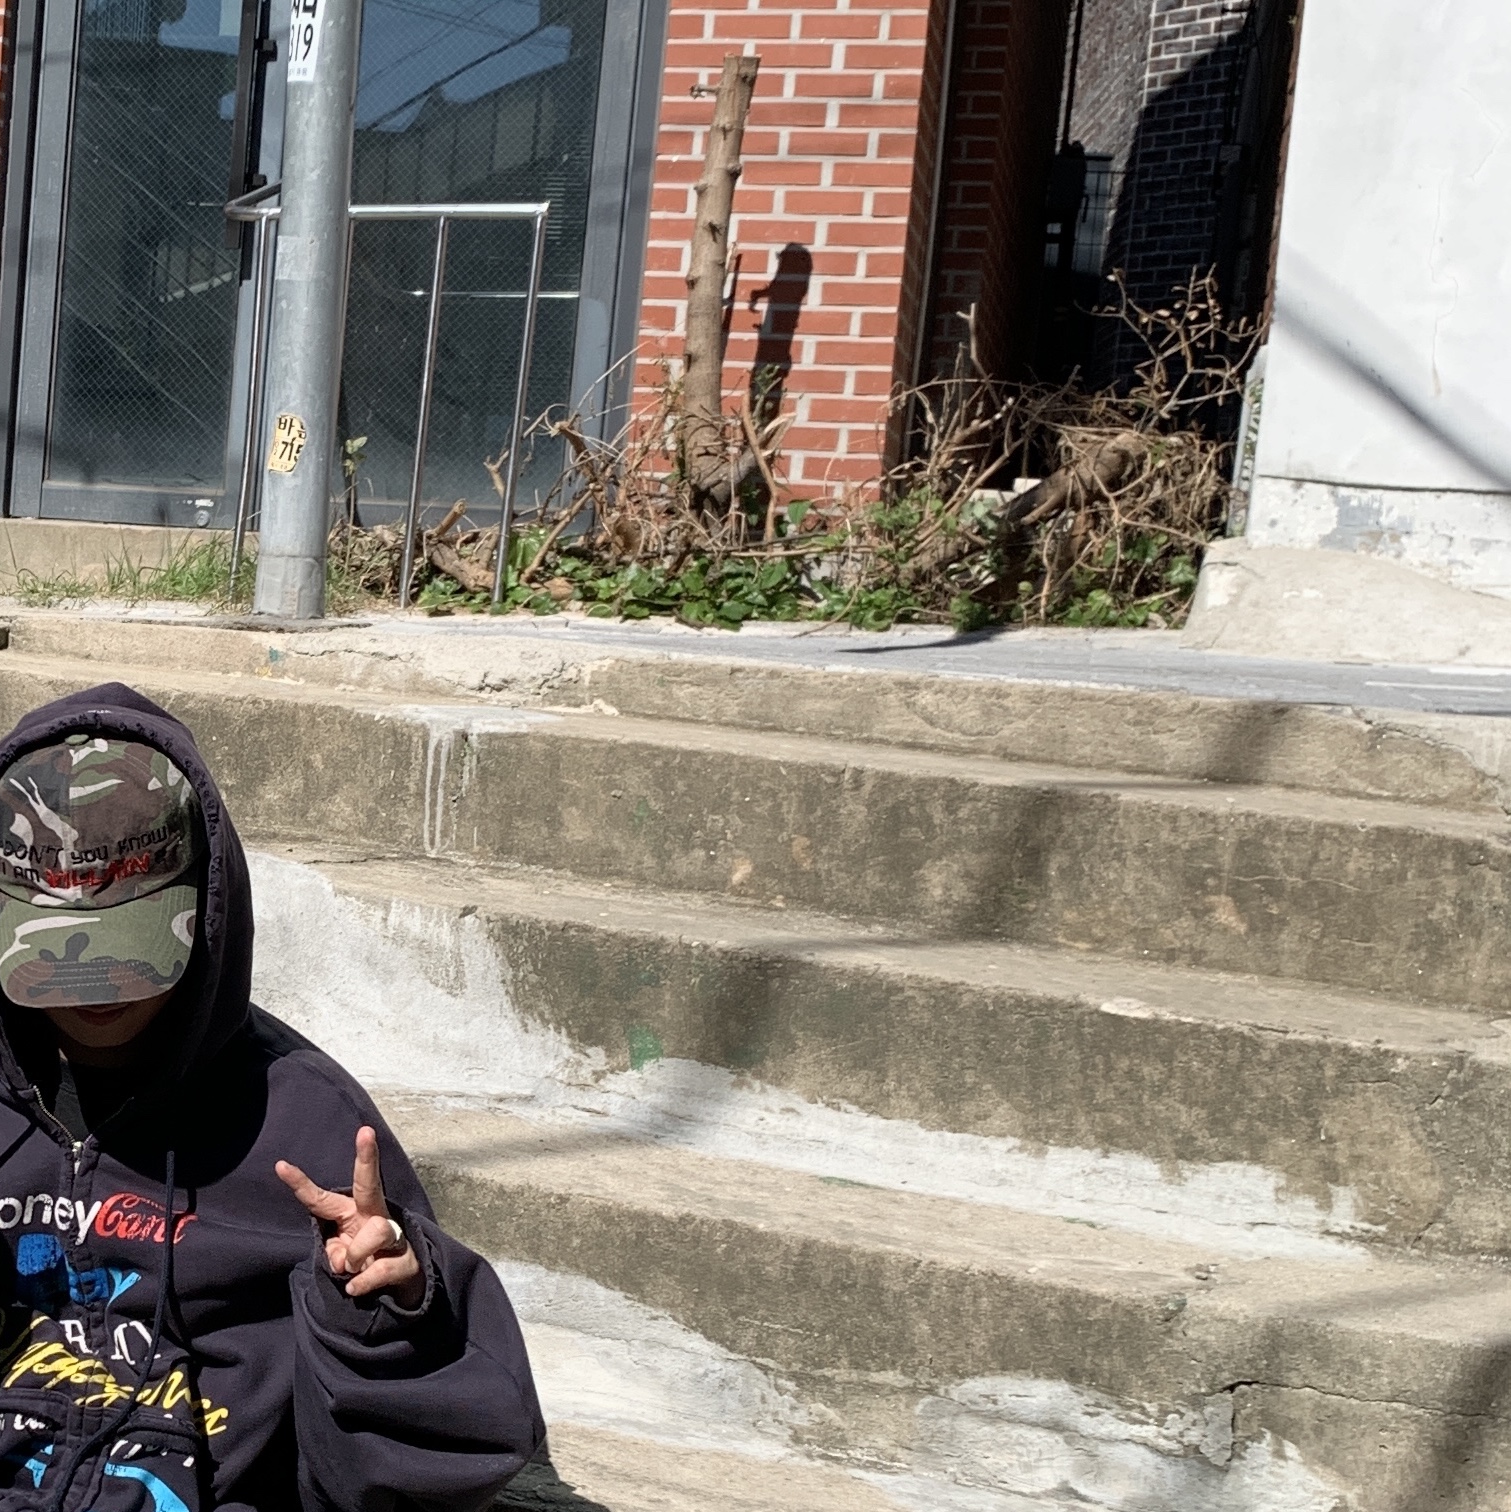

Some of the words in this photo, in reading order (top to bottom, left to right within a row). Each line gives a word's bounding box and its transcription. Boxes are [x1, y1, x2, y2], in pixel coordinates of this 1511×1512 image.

[2, 839, 64, 868] DON'T
[70, 845, 109, 865] YOU
[13, 866, 40, 883] AM
